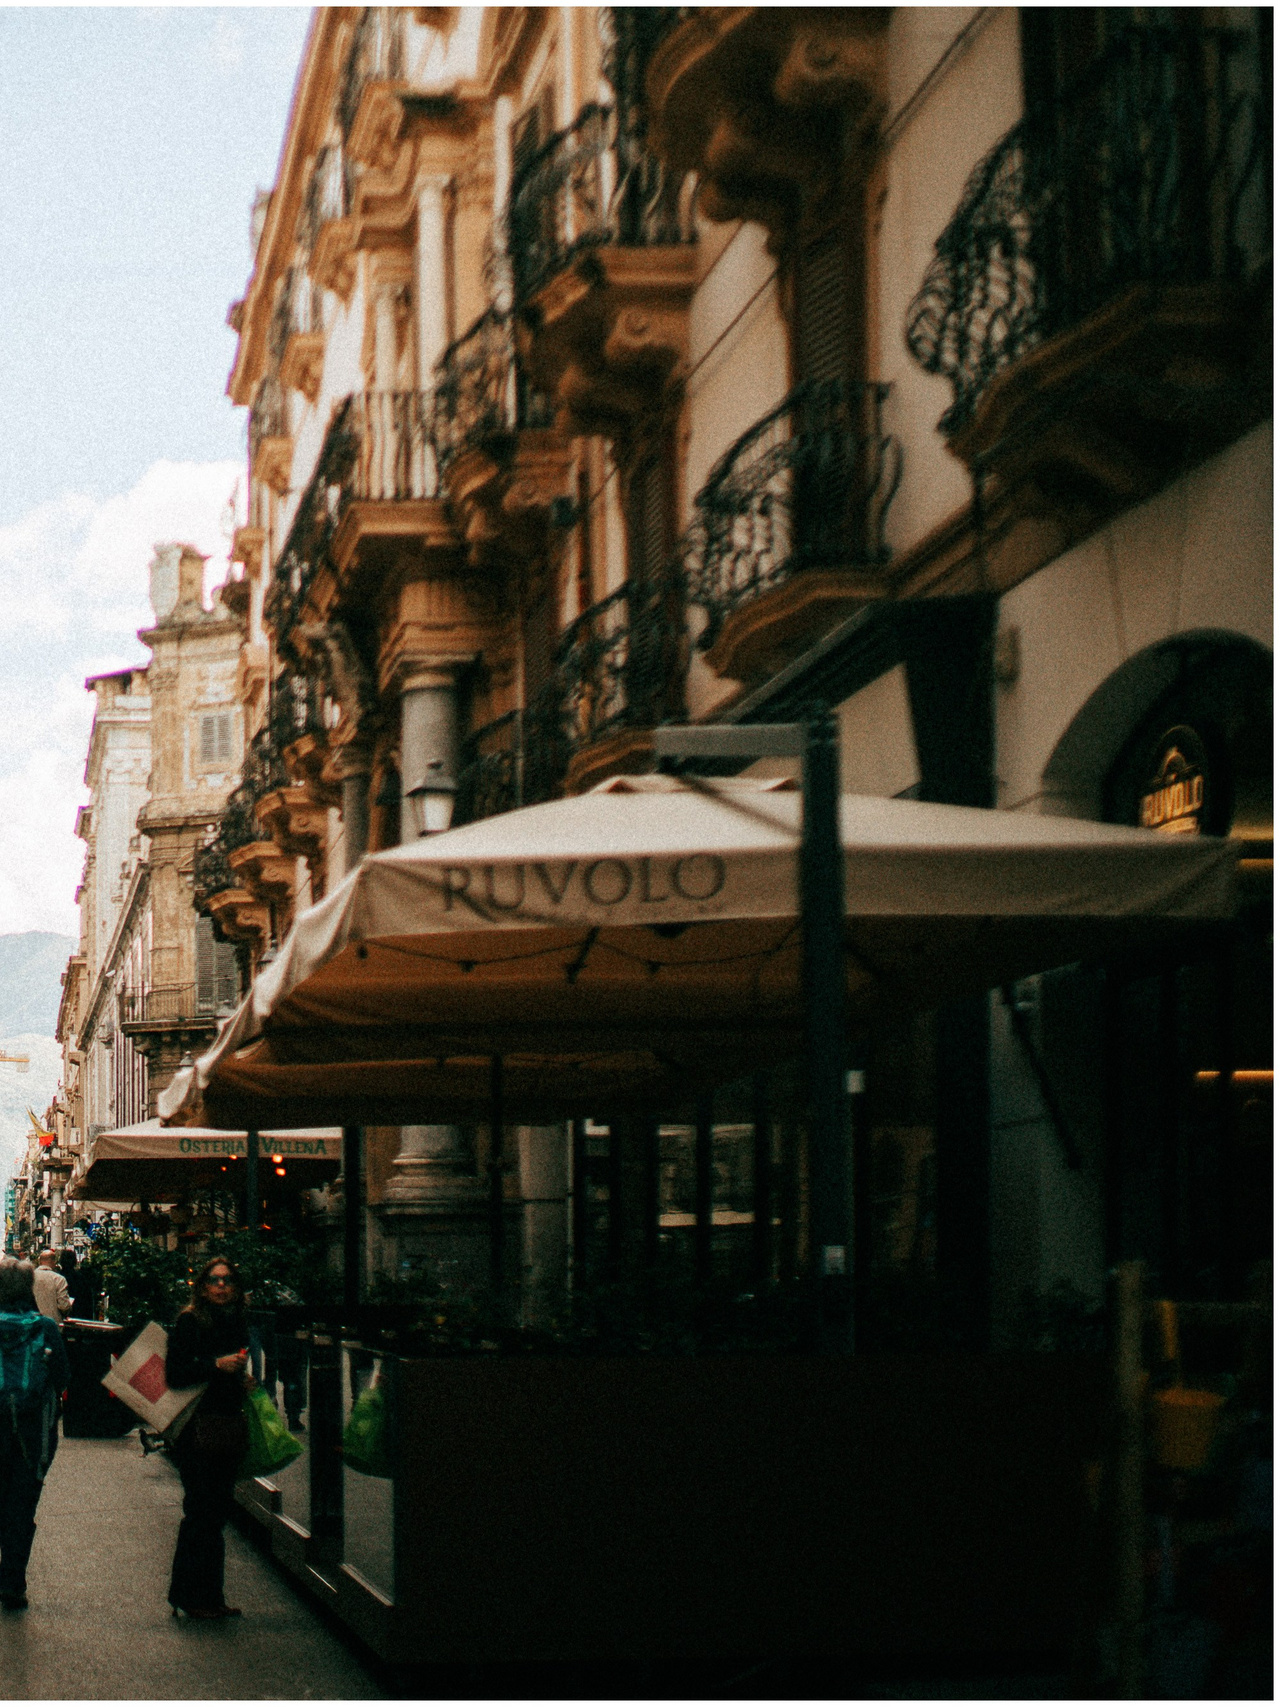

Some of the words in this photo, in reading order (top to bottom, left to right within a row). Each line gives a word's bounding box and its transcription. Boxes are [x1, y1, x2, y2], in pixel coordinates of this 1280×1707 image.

[1141, 774, 1204, 827] RUVOLO
[442, 852, 725, 912] RUVOLO
[178, 1137, 246, 1155] OSTERIA
[260, 1137, 327, 1155] VILLENA
